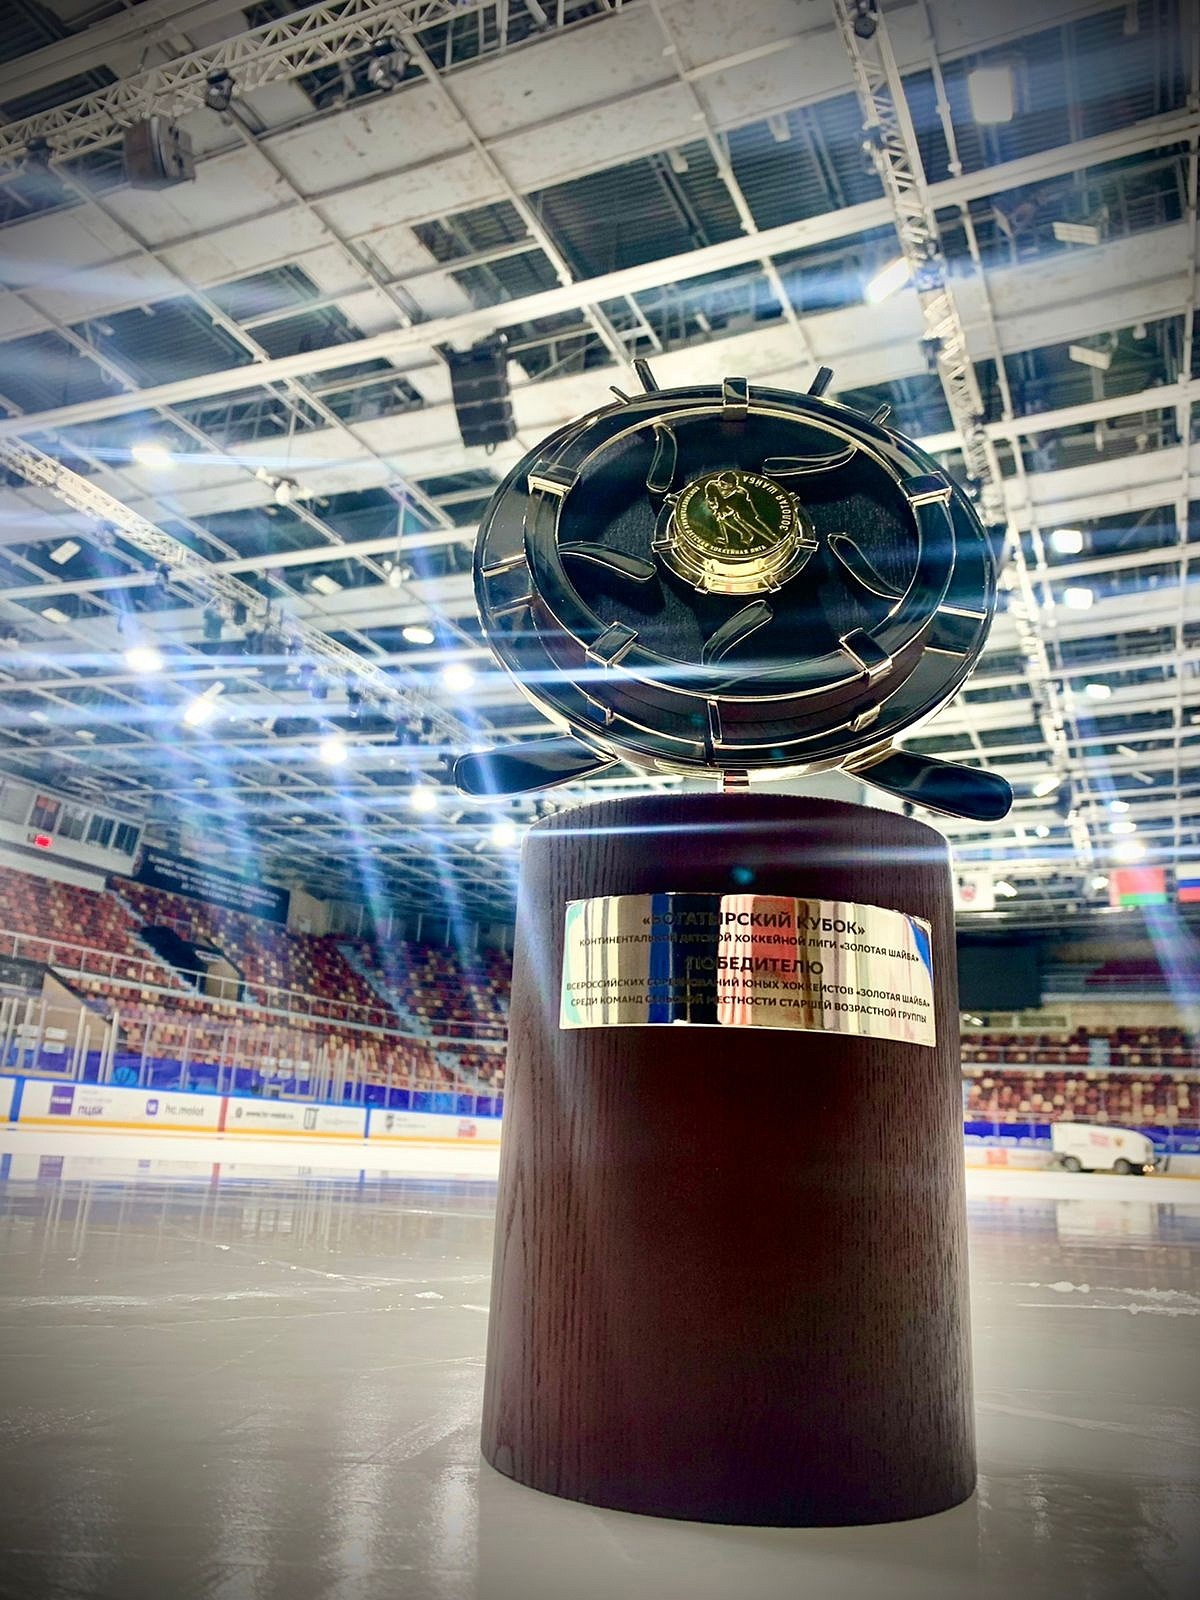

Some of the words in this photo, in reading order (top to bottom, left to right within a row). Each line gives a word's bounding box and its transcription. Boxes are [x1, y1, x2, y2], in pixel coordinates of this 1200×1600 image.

[743, 475, 779, 494] ШАЙБА
[776, 494, 792, 531] ЗОЛОТАЯ
[797, 915, 866, 935] КУБОК»
[734, 933, 806, 946] ХОККЕЙНОЙ
[808, 937, 837, 949] ЛИГИ
[839, 941, 888, 955] «ЗОЛОТАЯ
[888, 947, 919, 962] ШАЙБА»
[685, 956, 824, 975] ПОБЕДИТЕЛЮ
[566, 978, 645, 991] ВСЕРОССИЙСКИХ
[742, 978, 779, 990] ЮНЫХ
[855, 987, 901, 1002] «ЗОЛОТАЯ
[902, 995, 931, 1008] ШАЙБА»
[570, 997, 598, 1007] СРЕДИ
[600, 995, 643, 1005] КОМАНД
[780, 998, 832, 1010] СТАРШЕЙ
[834, 1002, 897, 1017] ВОЗРАСТНОЙ
[898, 1010, 927, 1024] ГРУППЫ
